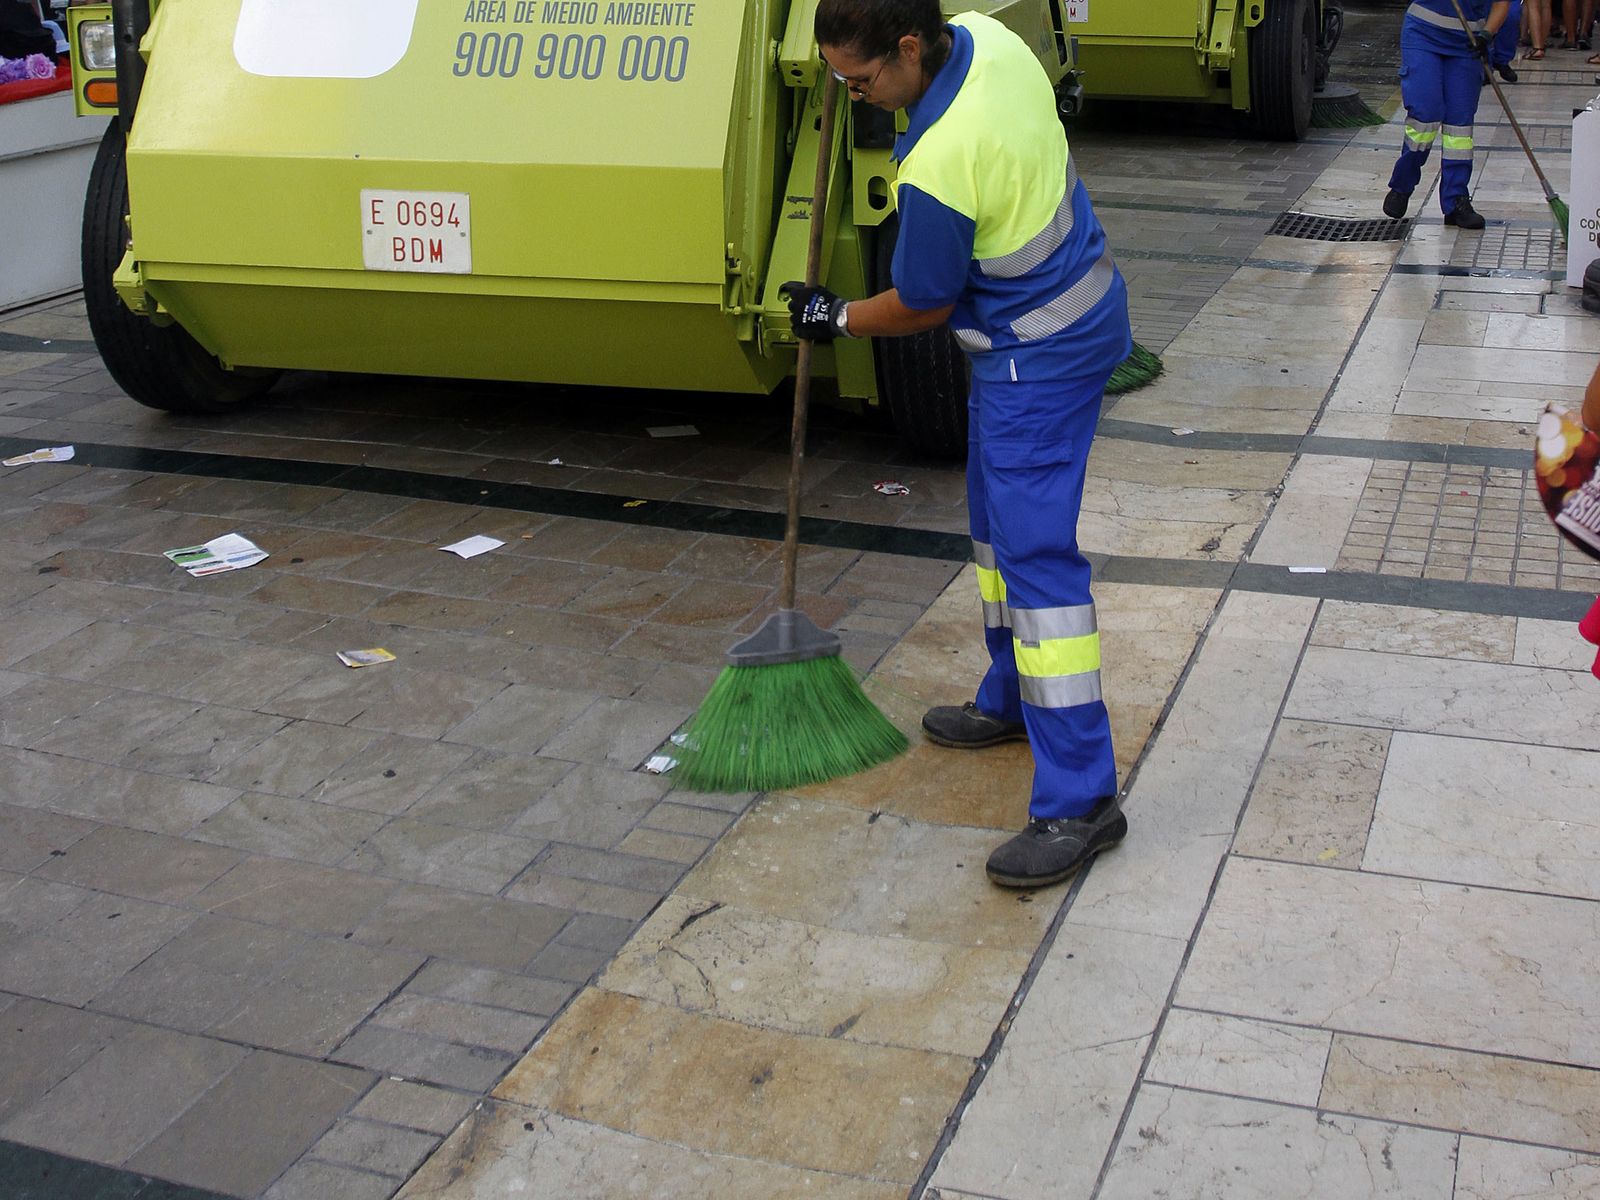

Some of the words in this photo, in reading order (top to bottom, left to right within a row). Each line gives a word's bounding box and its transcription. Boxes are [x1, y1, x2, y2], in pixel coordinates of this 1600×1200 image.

[464, 0, 507, 24] AREA
[512, 0, 537, 24] DE
[541, 0, 599, 25] MEDIO
[603, 1, 696, 27] AMBIENTE
[452, 31, 524, 79] 900
[534, 33, 607, 81] 900
[617, 34, 690, 83] 000
[371, 199, 385, 225] E
[397, 200, 460, 229] 0694
[392, 236, 444, 264] BDM
